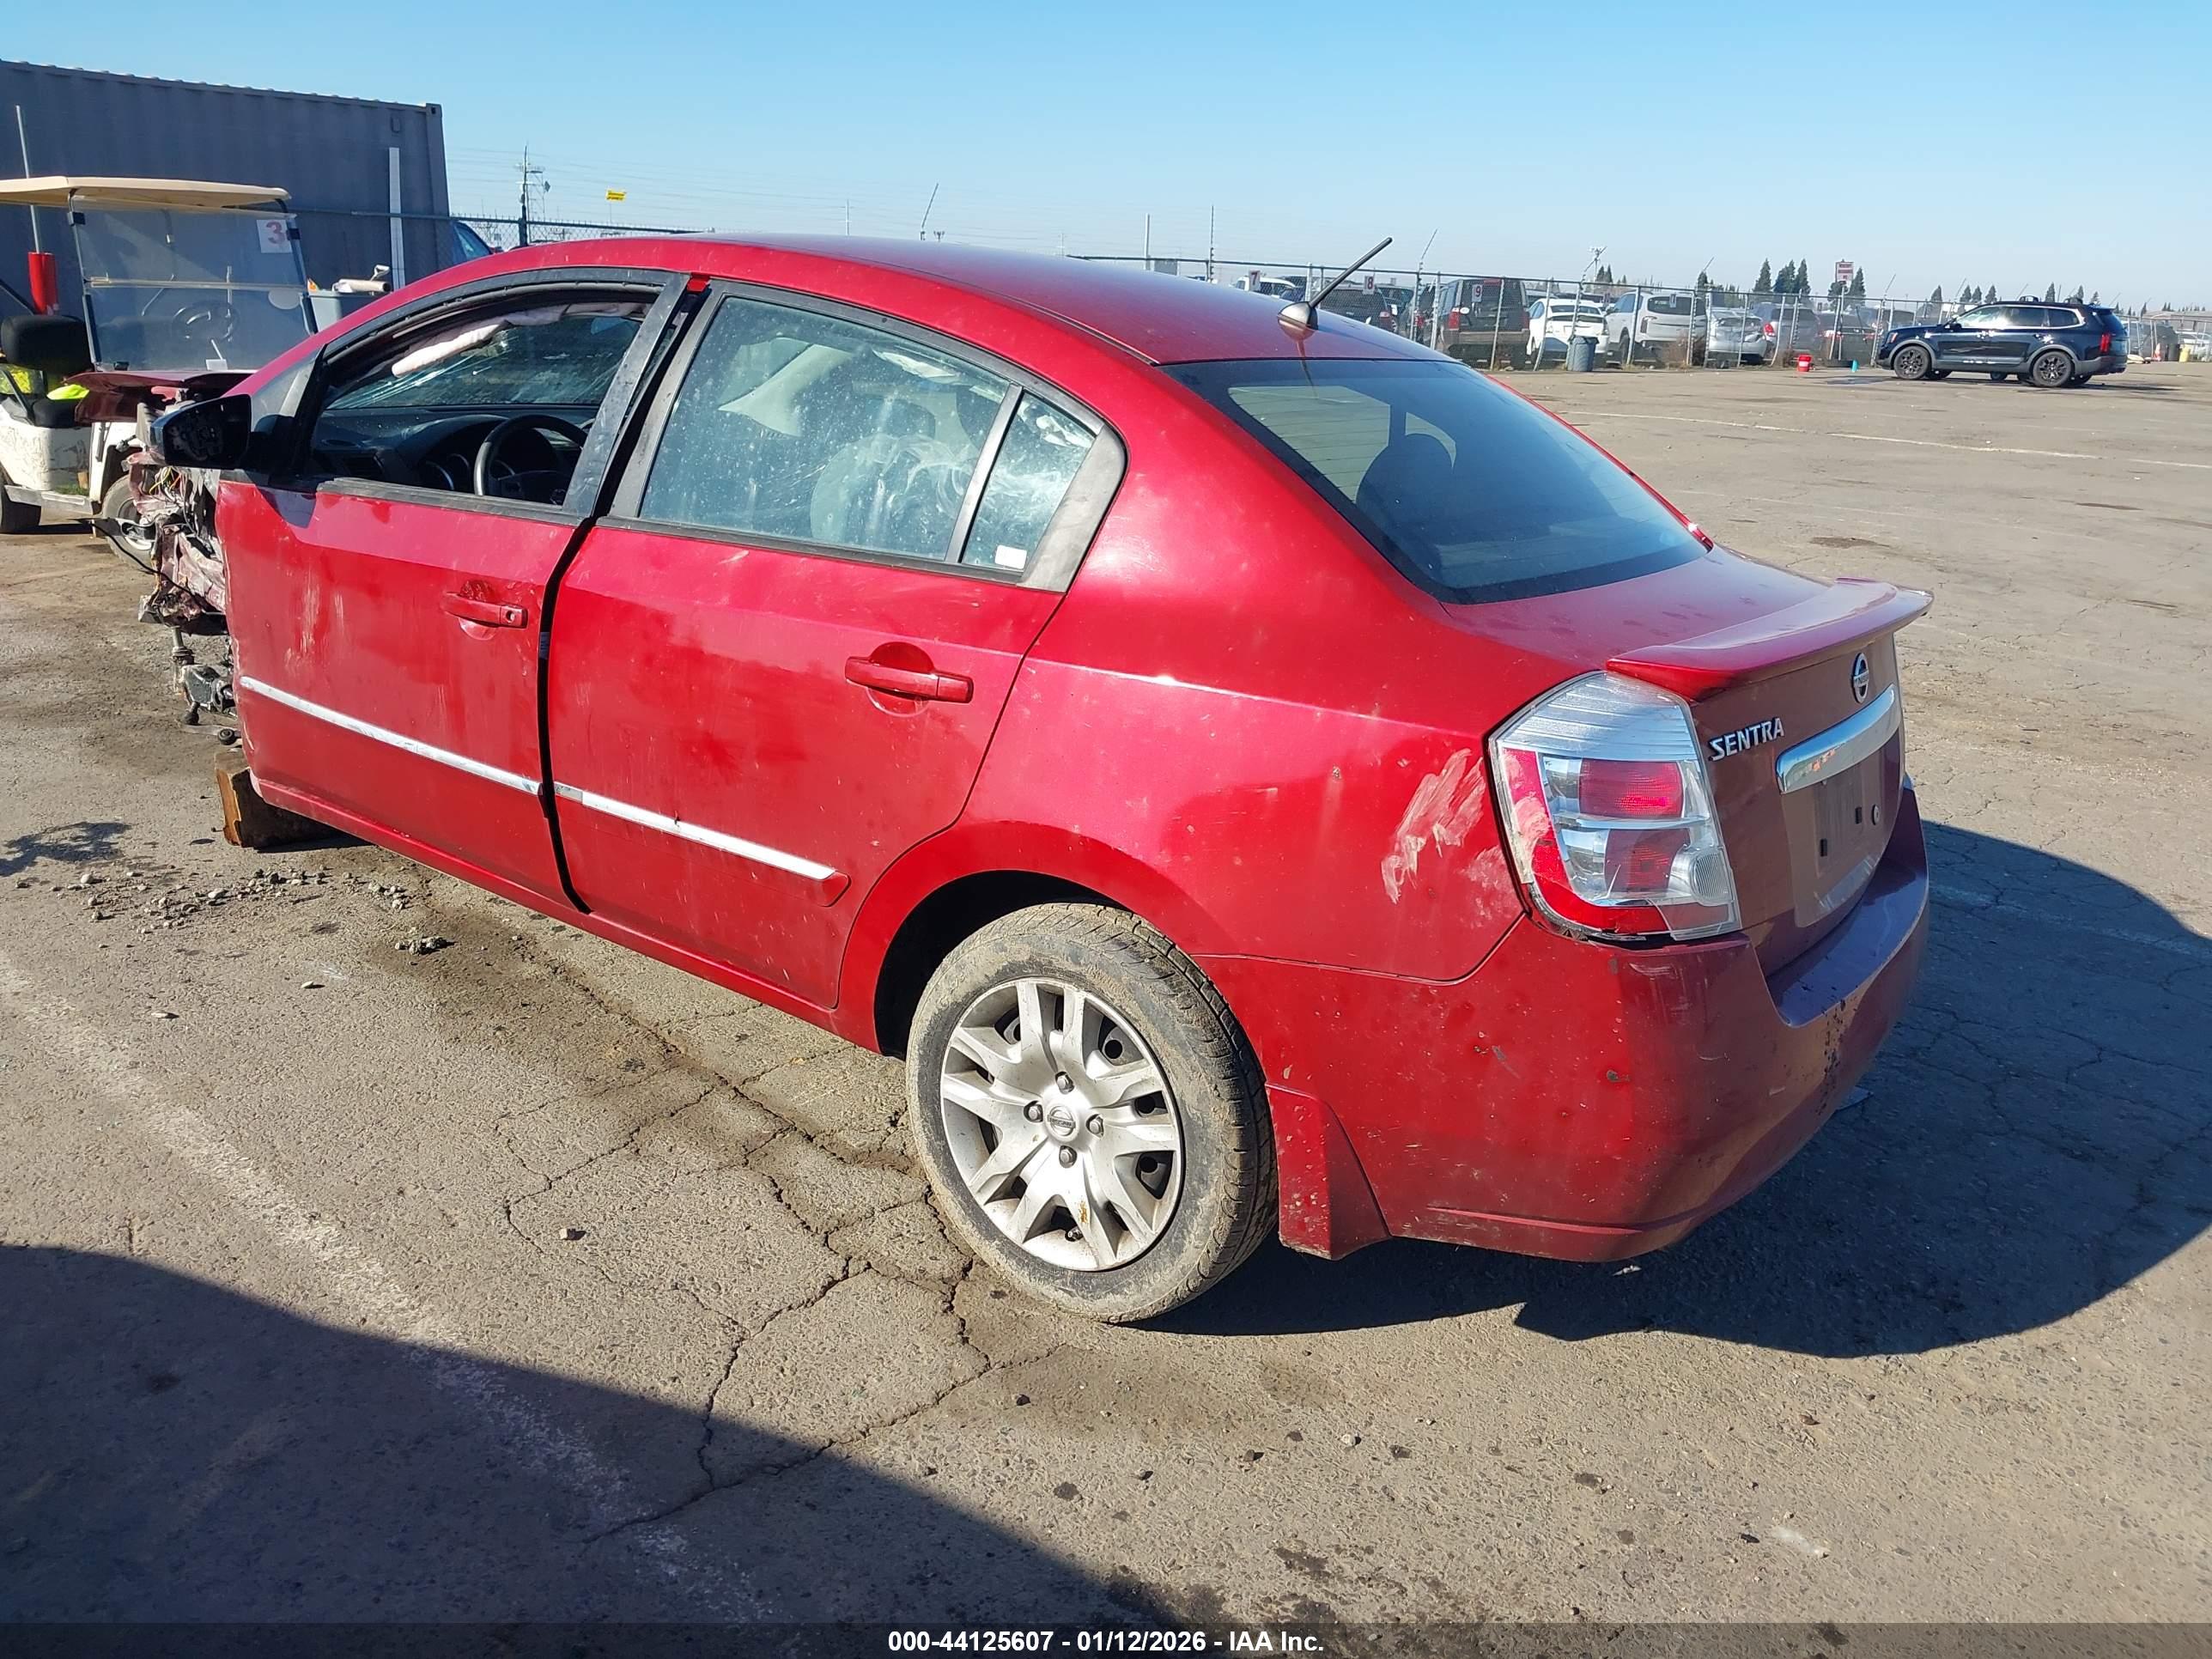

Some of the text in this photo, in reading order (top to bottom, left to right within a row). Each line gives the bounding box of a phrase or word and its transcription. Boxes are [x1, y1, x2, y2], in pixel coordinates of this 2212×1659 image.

[266, 221, 286, 245] 3
[1251, 271, 1258, 286] 7
[1367, 276, 1374, 290] 8
[1475, 285, 1481, 297] 9
[1708, 716, 1785, 762] SENTRA
